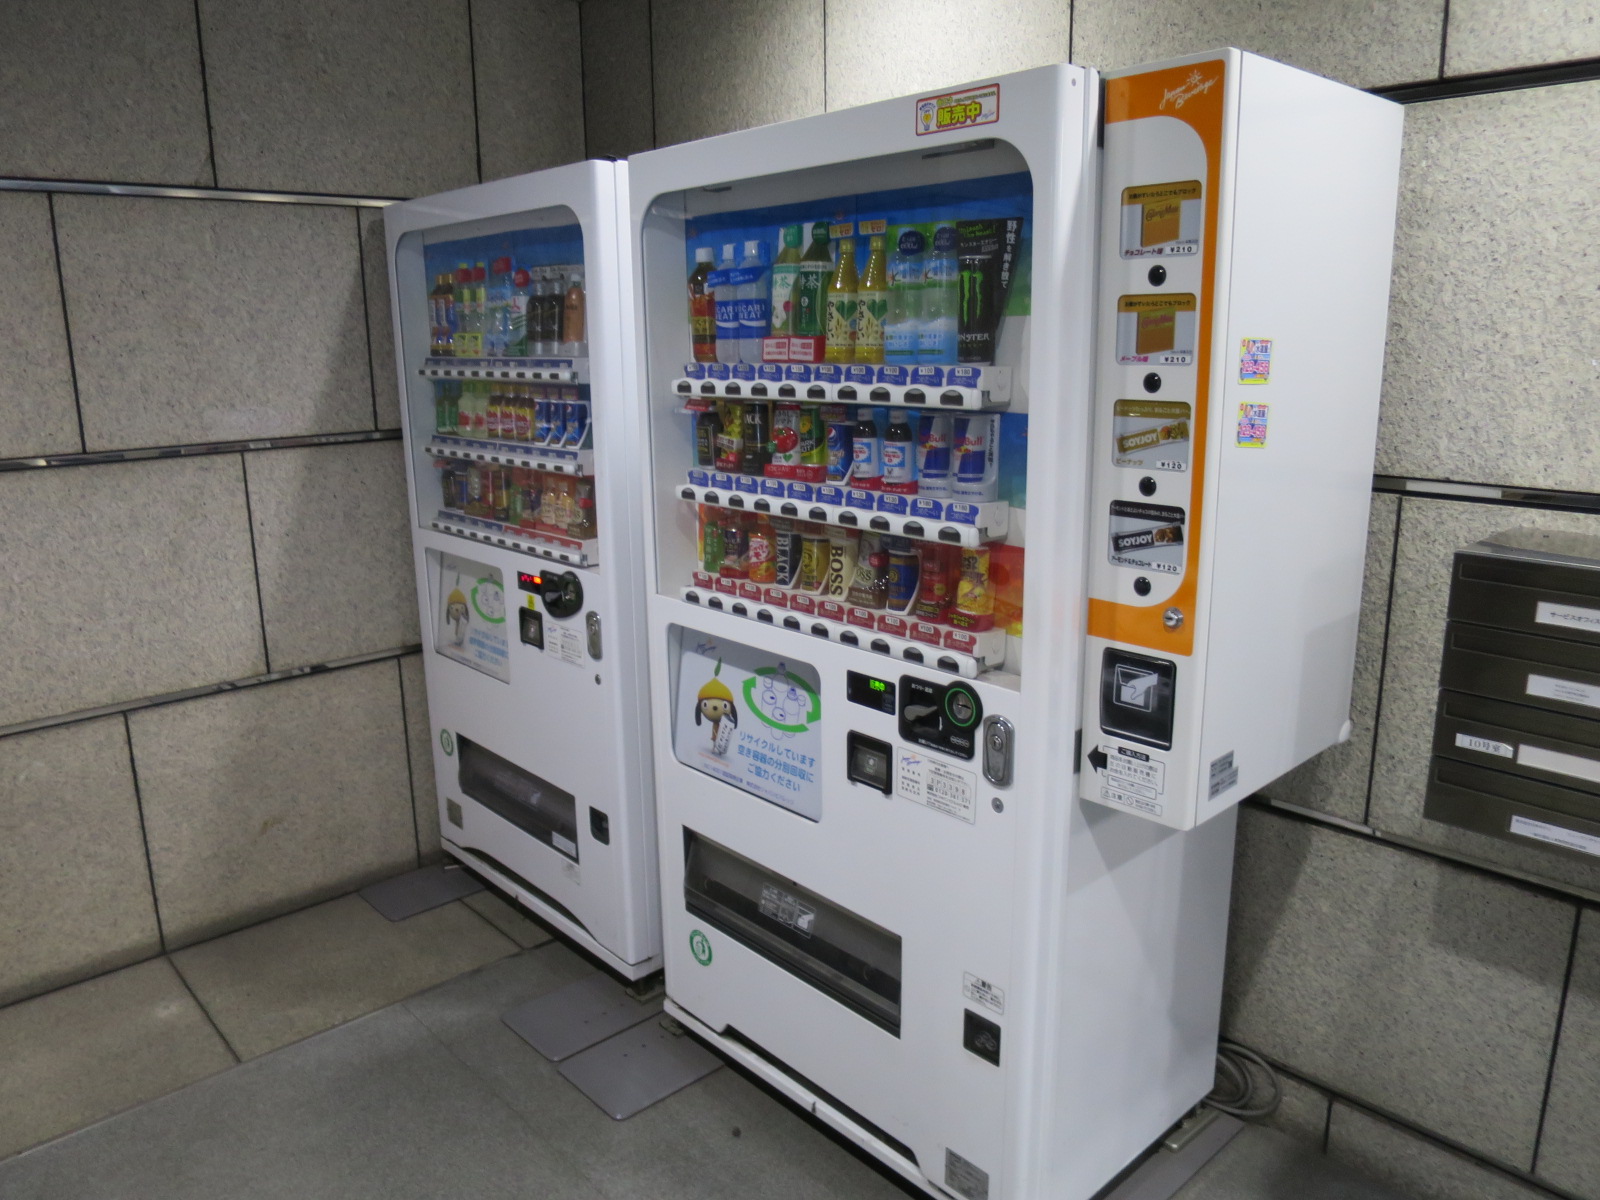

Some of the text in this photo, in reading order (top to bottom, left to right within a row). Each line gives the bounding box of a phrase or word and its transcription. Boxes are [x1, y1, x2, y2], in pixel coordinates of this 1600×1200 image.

[937, 101, 981, 127] 販売中
[1123, 432, 1157, 448] SOYJOY
[1118, 533, 1153, 547] SOYJOY
[776, 536, 789, 584] BLACK
[830, 546, 843, 596] BOSS
[1156, 563, 1177, 572] ¥120
[920, 625, 933, 633] ¥100
[740, 731, 815, 768] リサイクルしています
[737, 744, 814, 783] 空き容器の分別回収に
[747, 763, 801, 792] ご協力ください
